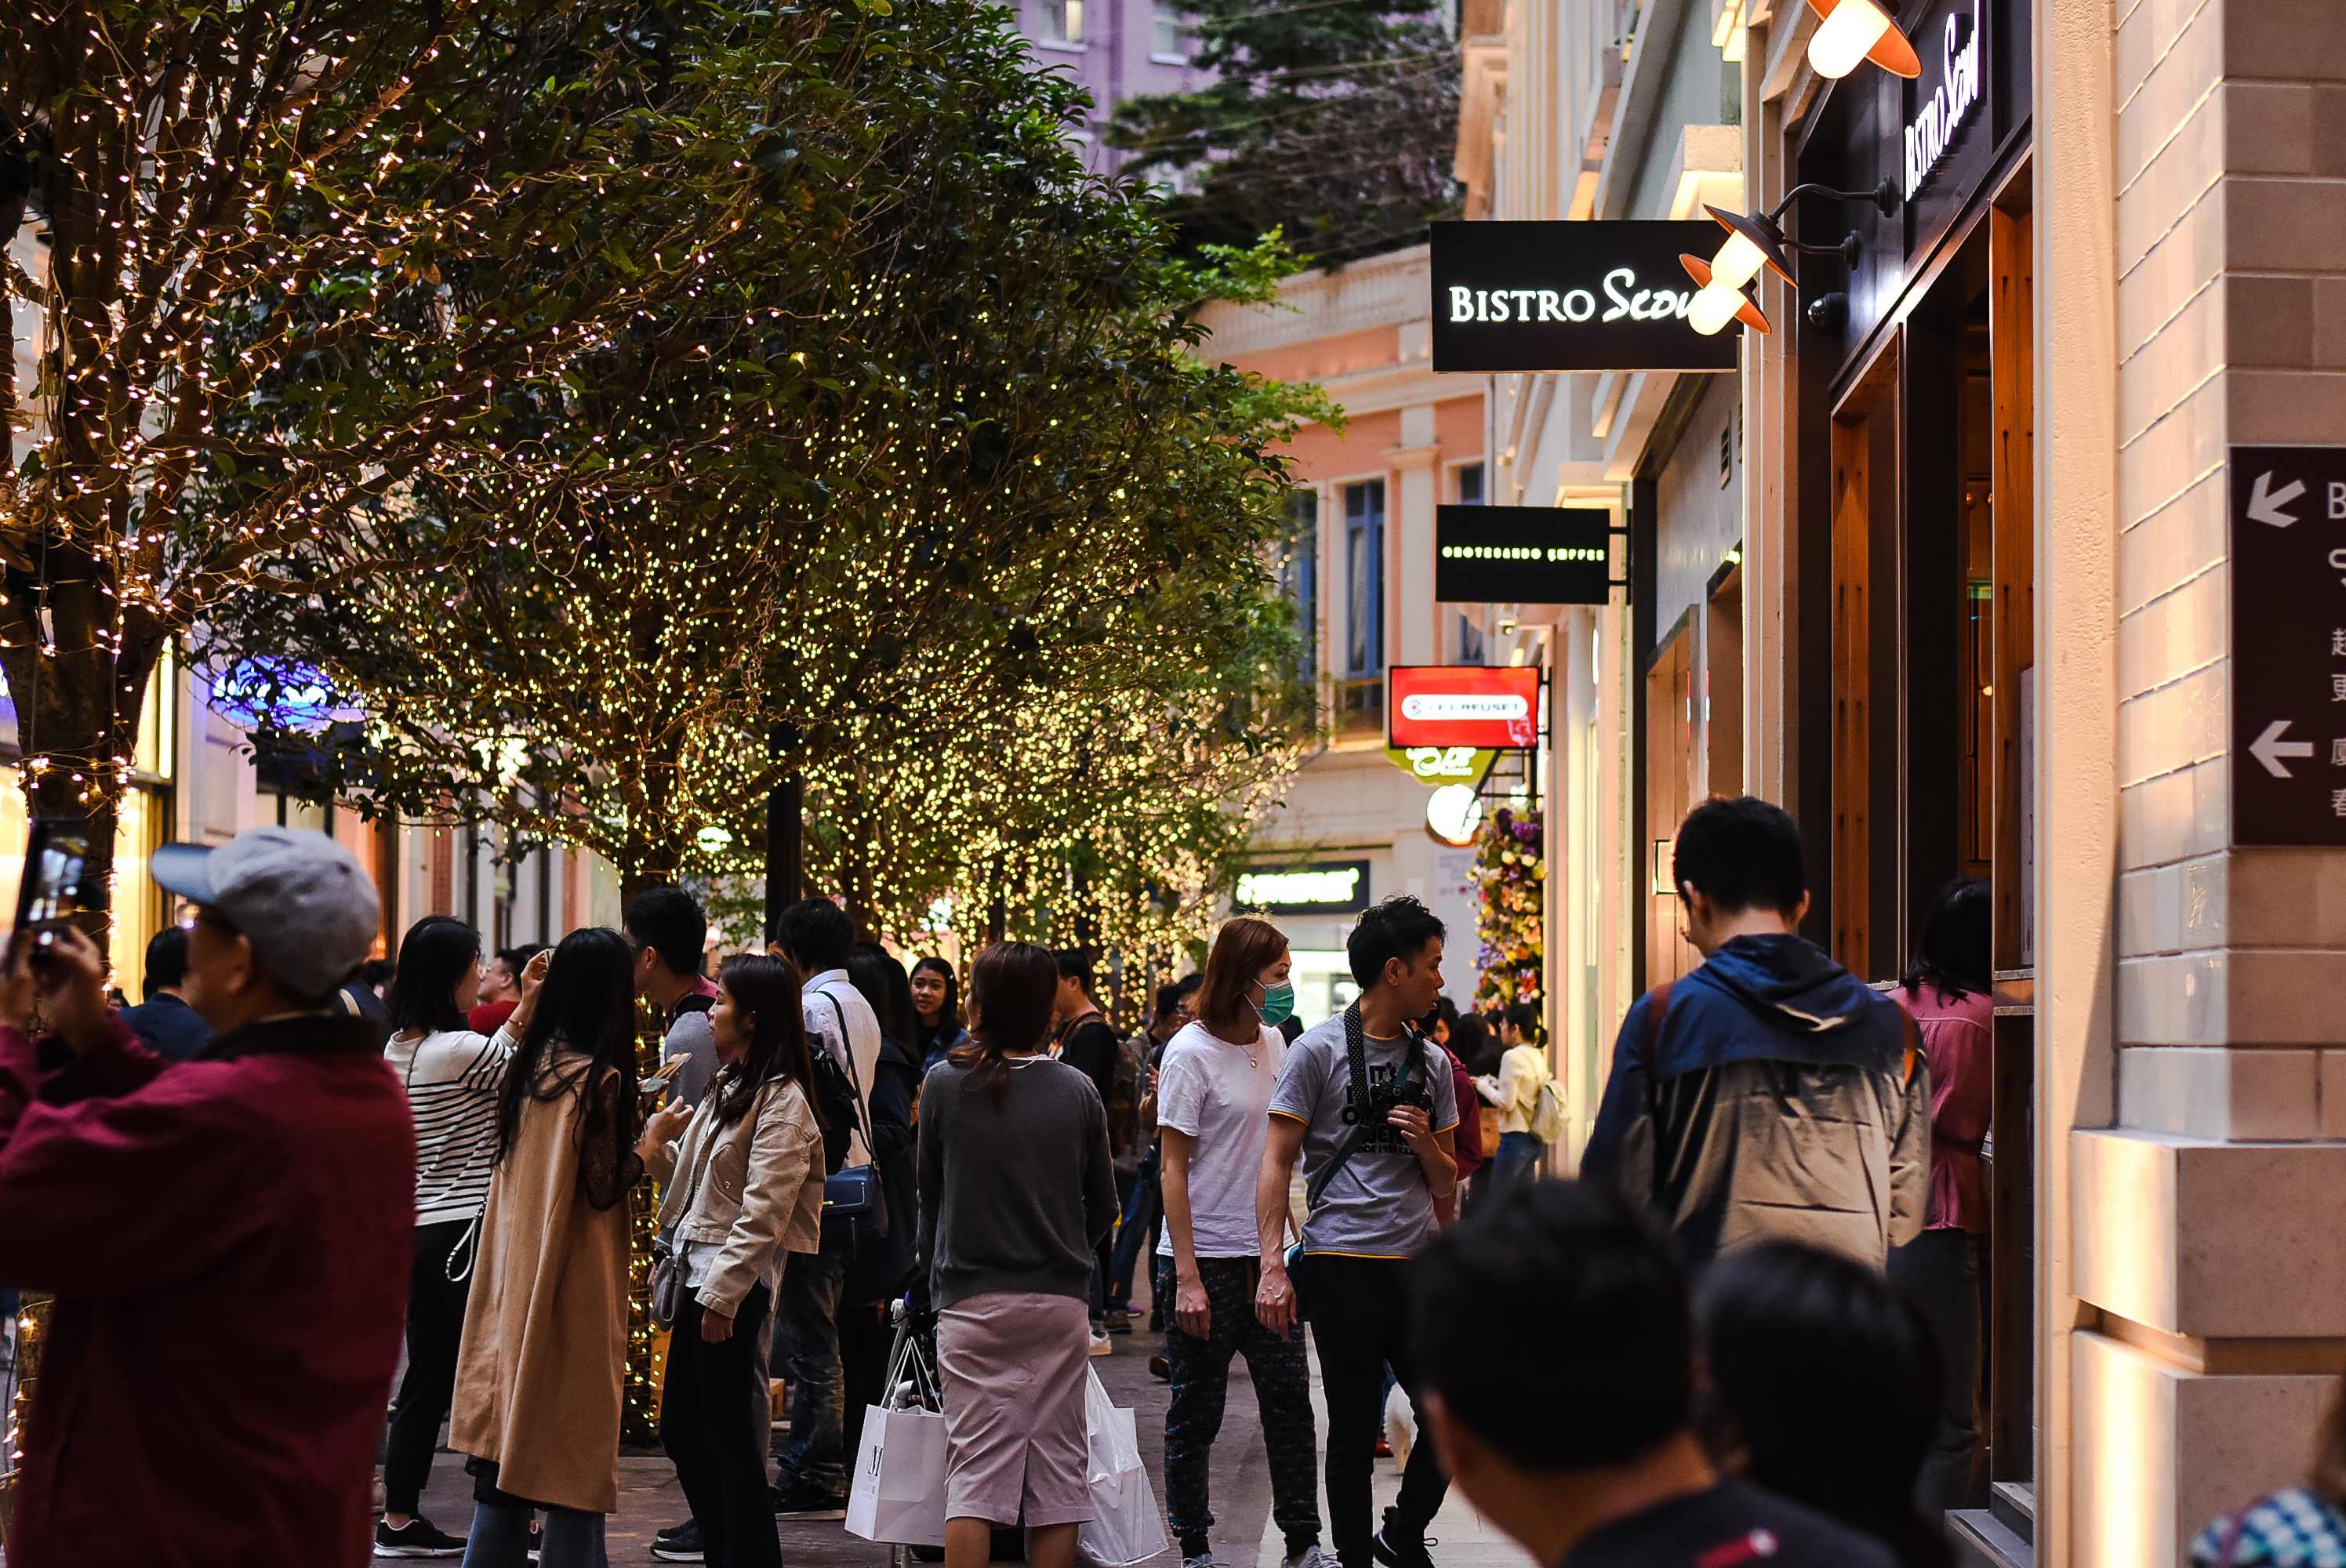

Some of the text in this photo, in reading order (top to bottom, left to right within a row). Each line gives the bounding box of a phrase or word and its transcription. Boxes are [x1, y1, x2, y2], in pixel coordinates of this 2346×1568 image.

[1448, 285, 1596, 323] BISTRO
[1429, 703, 1520, 712] LE CREUSET
